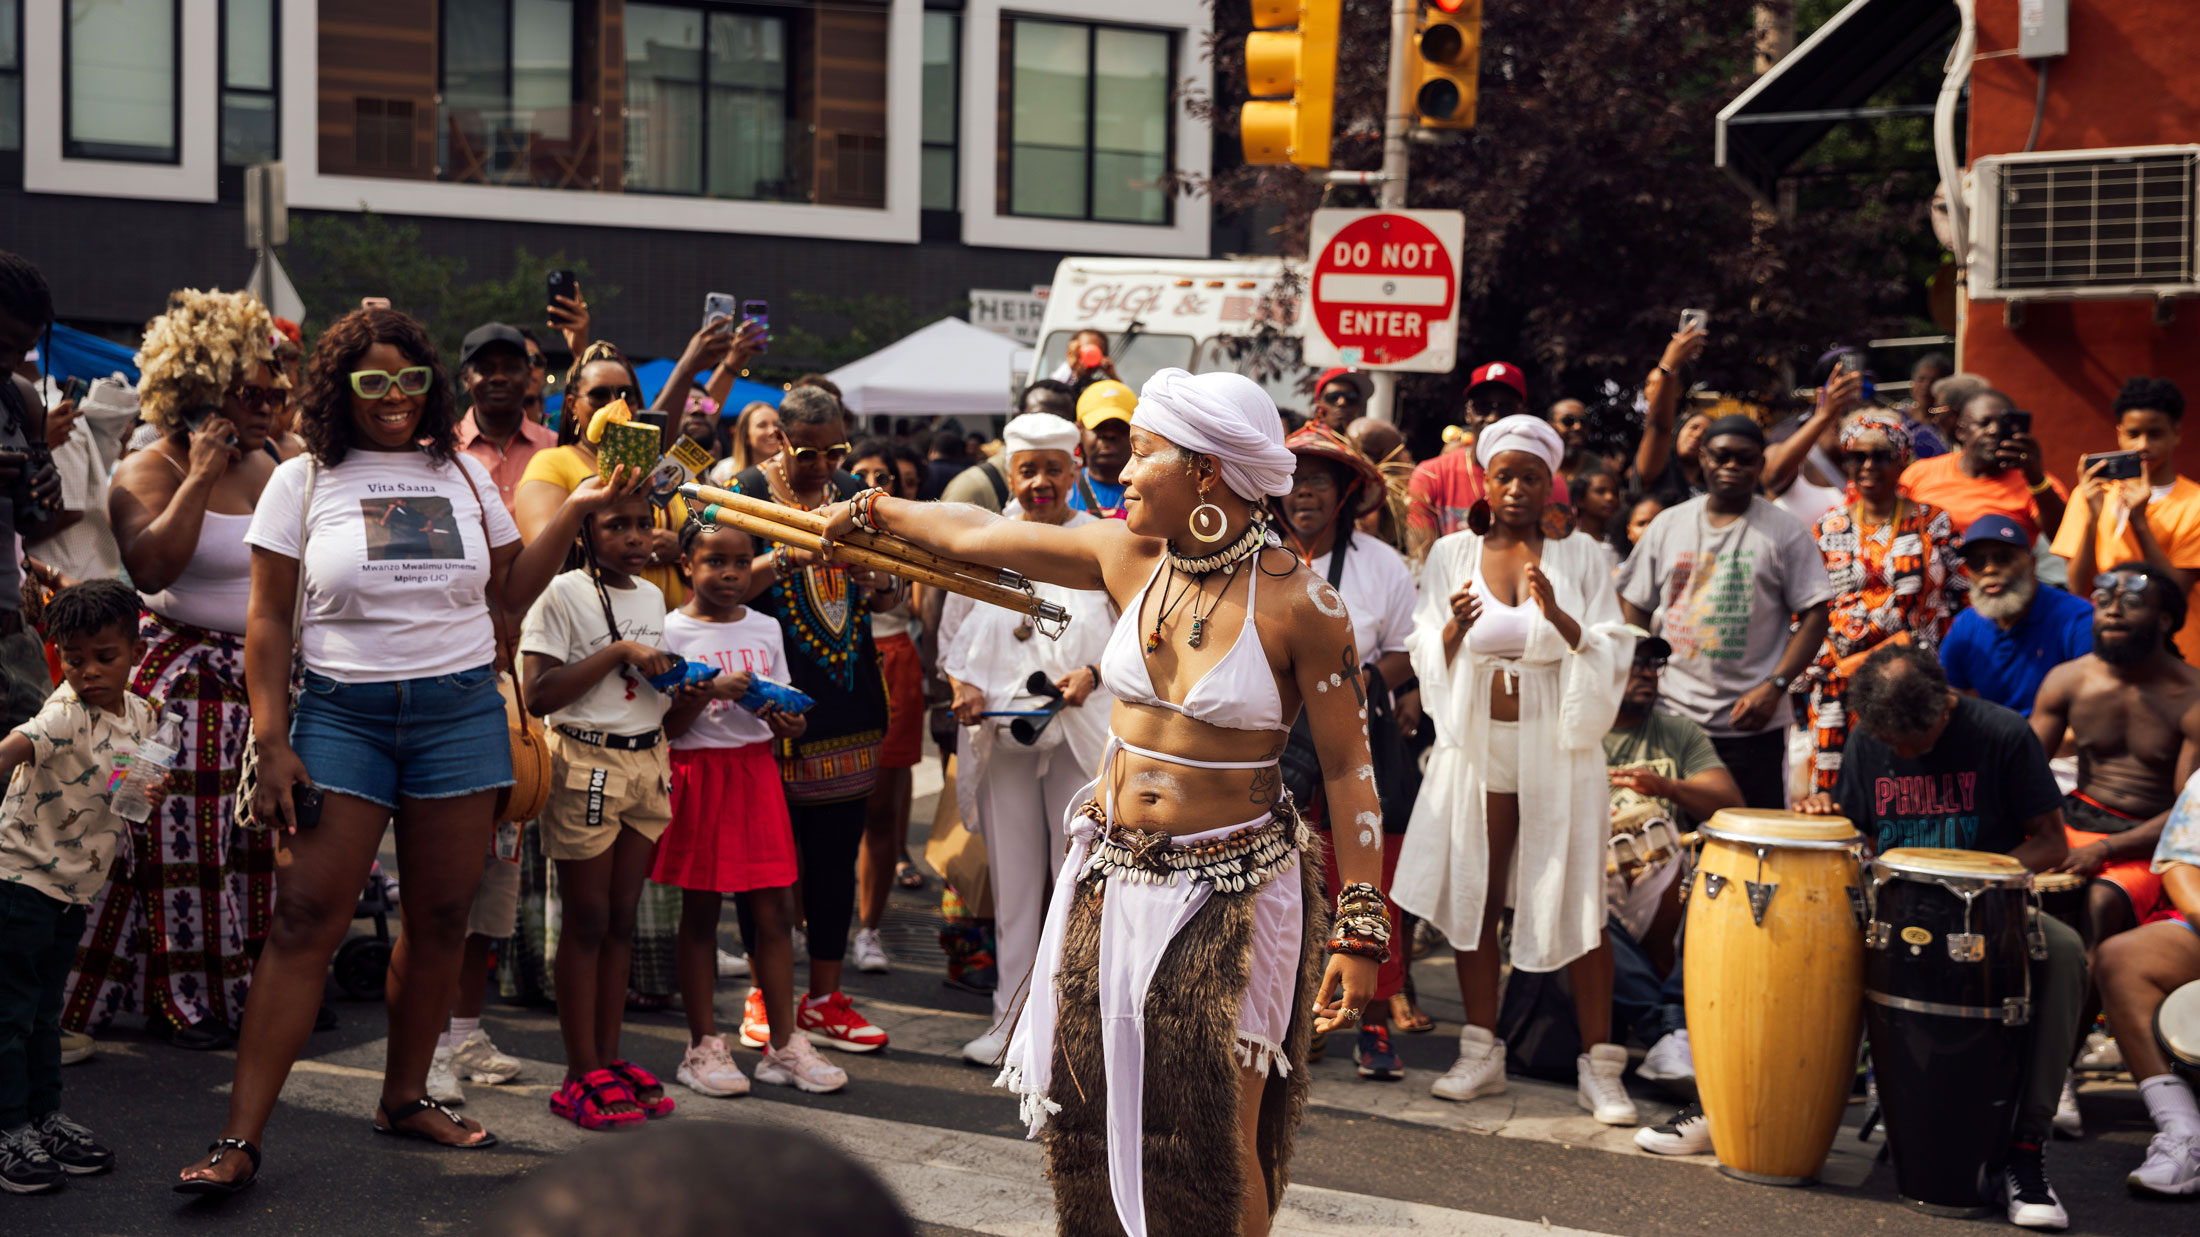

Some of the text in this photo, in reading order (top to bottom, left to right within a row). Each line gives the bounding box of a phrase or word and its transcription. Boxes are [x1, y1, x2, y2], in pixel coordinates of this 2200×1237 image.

[1333, 241, 1438, 269] DO NOT
[1173, 294, 1208, 316] &
[1338, 309, 1422, 338] ENTER
[368, 482, 436, 493] Vita Saana
[362, 564, 400, 572] Mwanzo
[402, 562, 443, 571] Mwalimu
[394, 573, 448, 584] Mpingo (JC)
[1875, 771, 1977, 816] PHILLY
